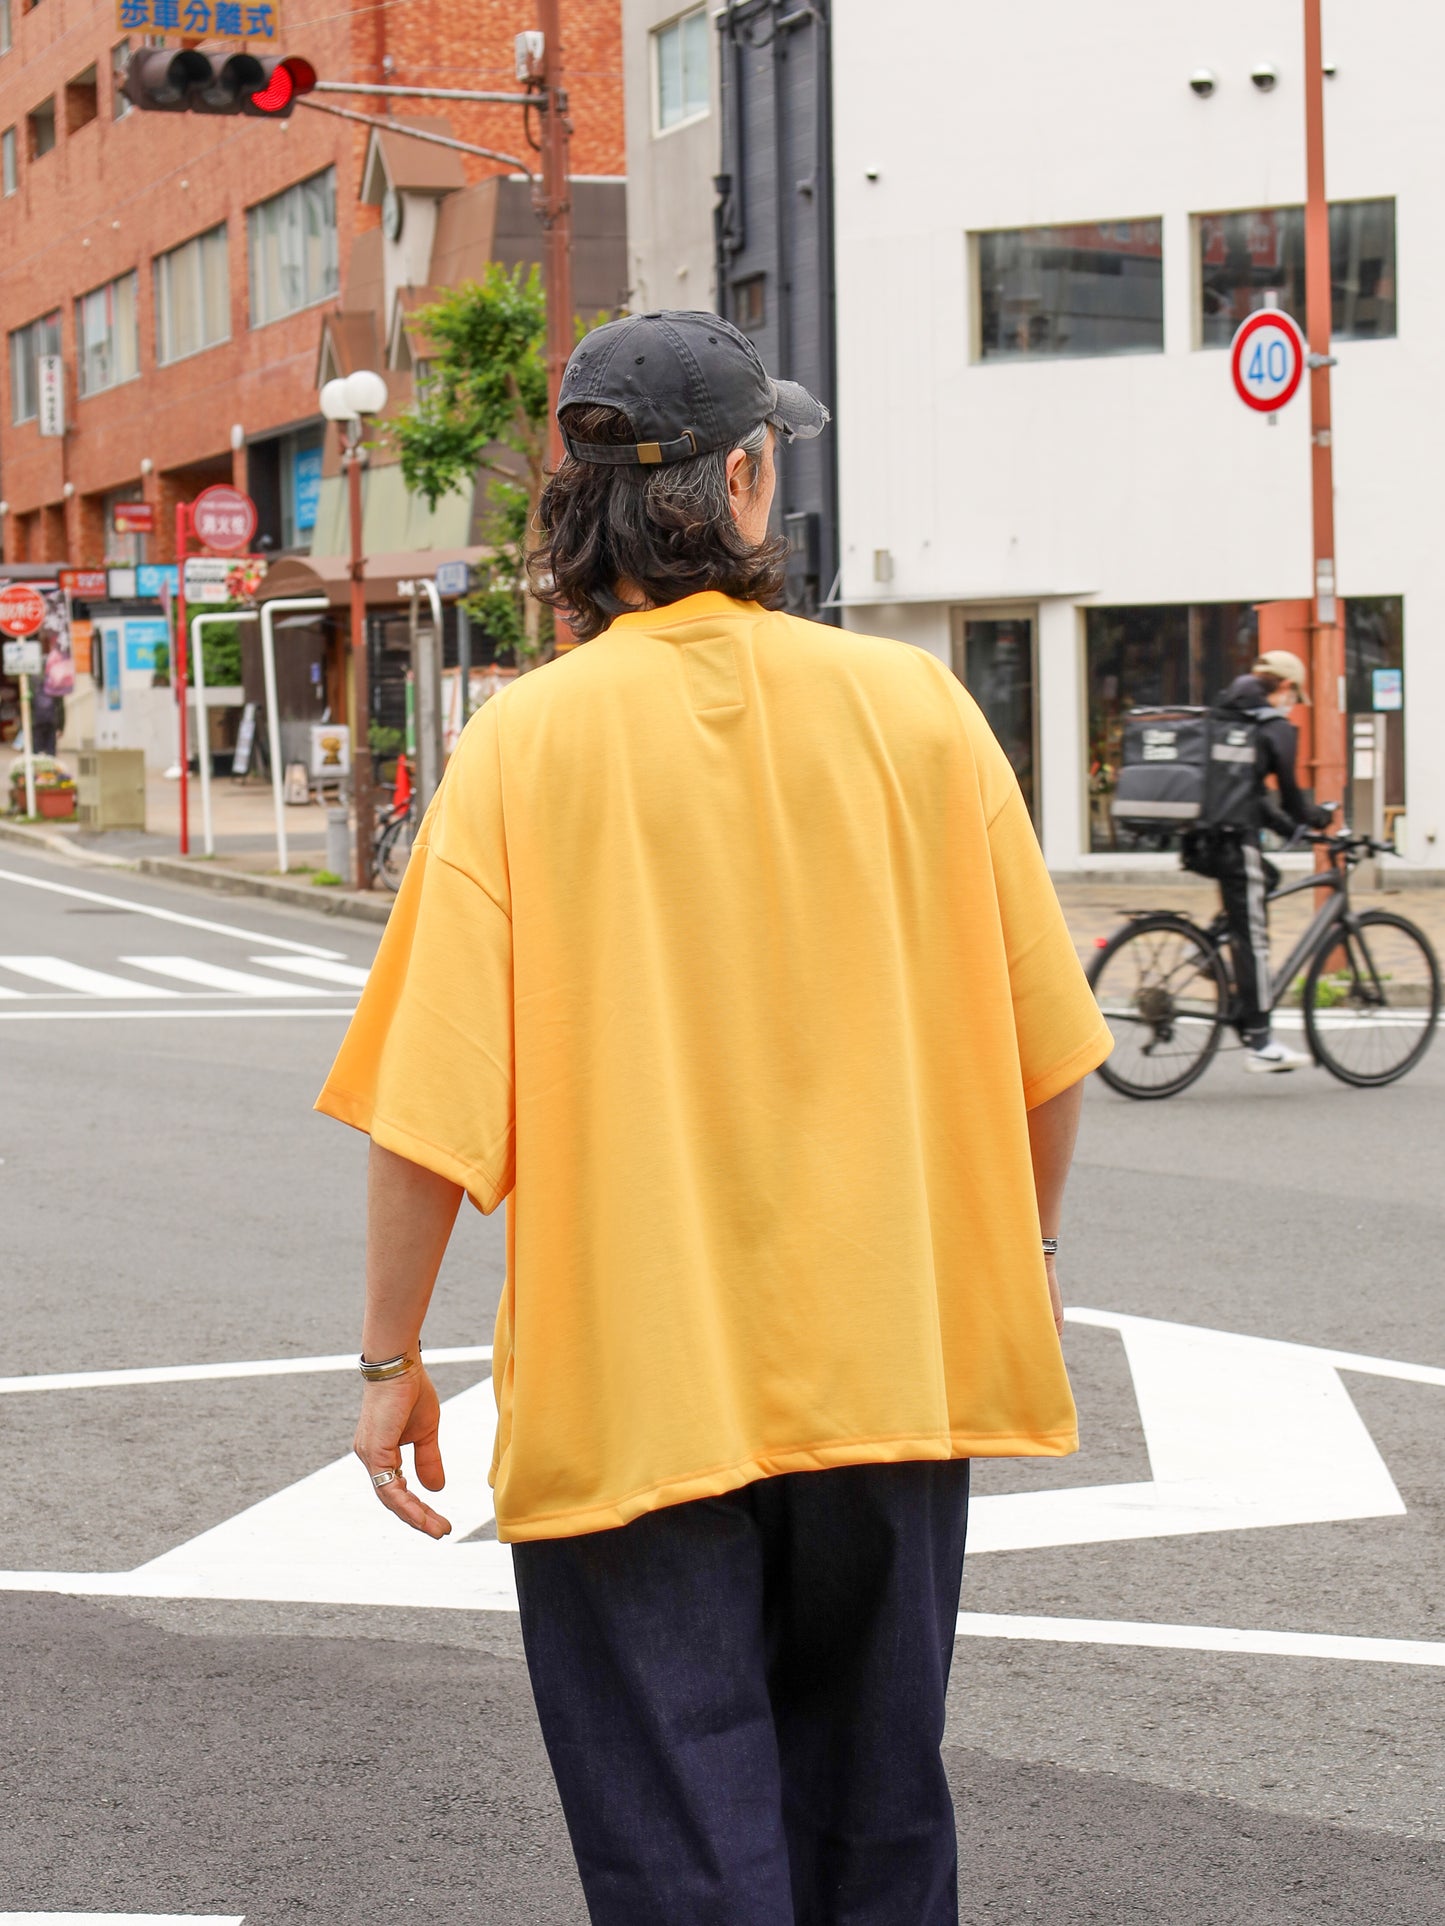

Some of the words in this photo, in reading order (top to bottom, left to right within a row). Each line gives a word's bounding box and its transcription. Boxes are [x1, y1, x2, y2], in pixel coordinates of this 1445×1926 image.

[120, 0, 274, 38] 歩車分離式
[1248, 340, 1288, 384] 40
